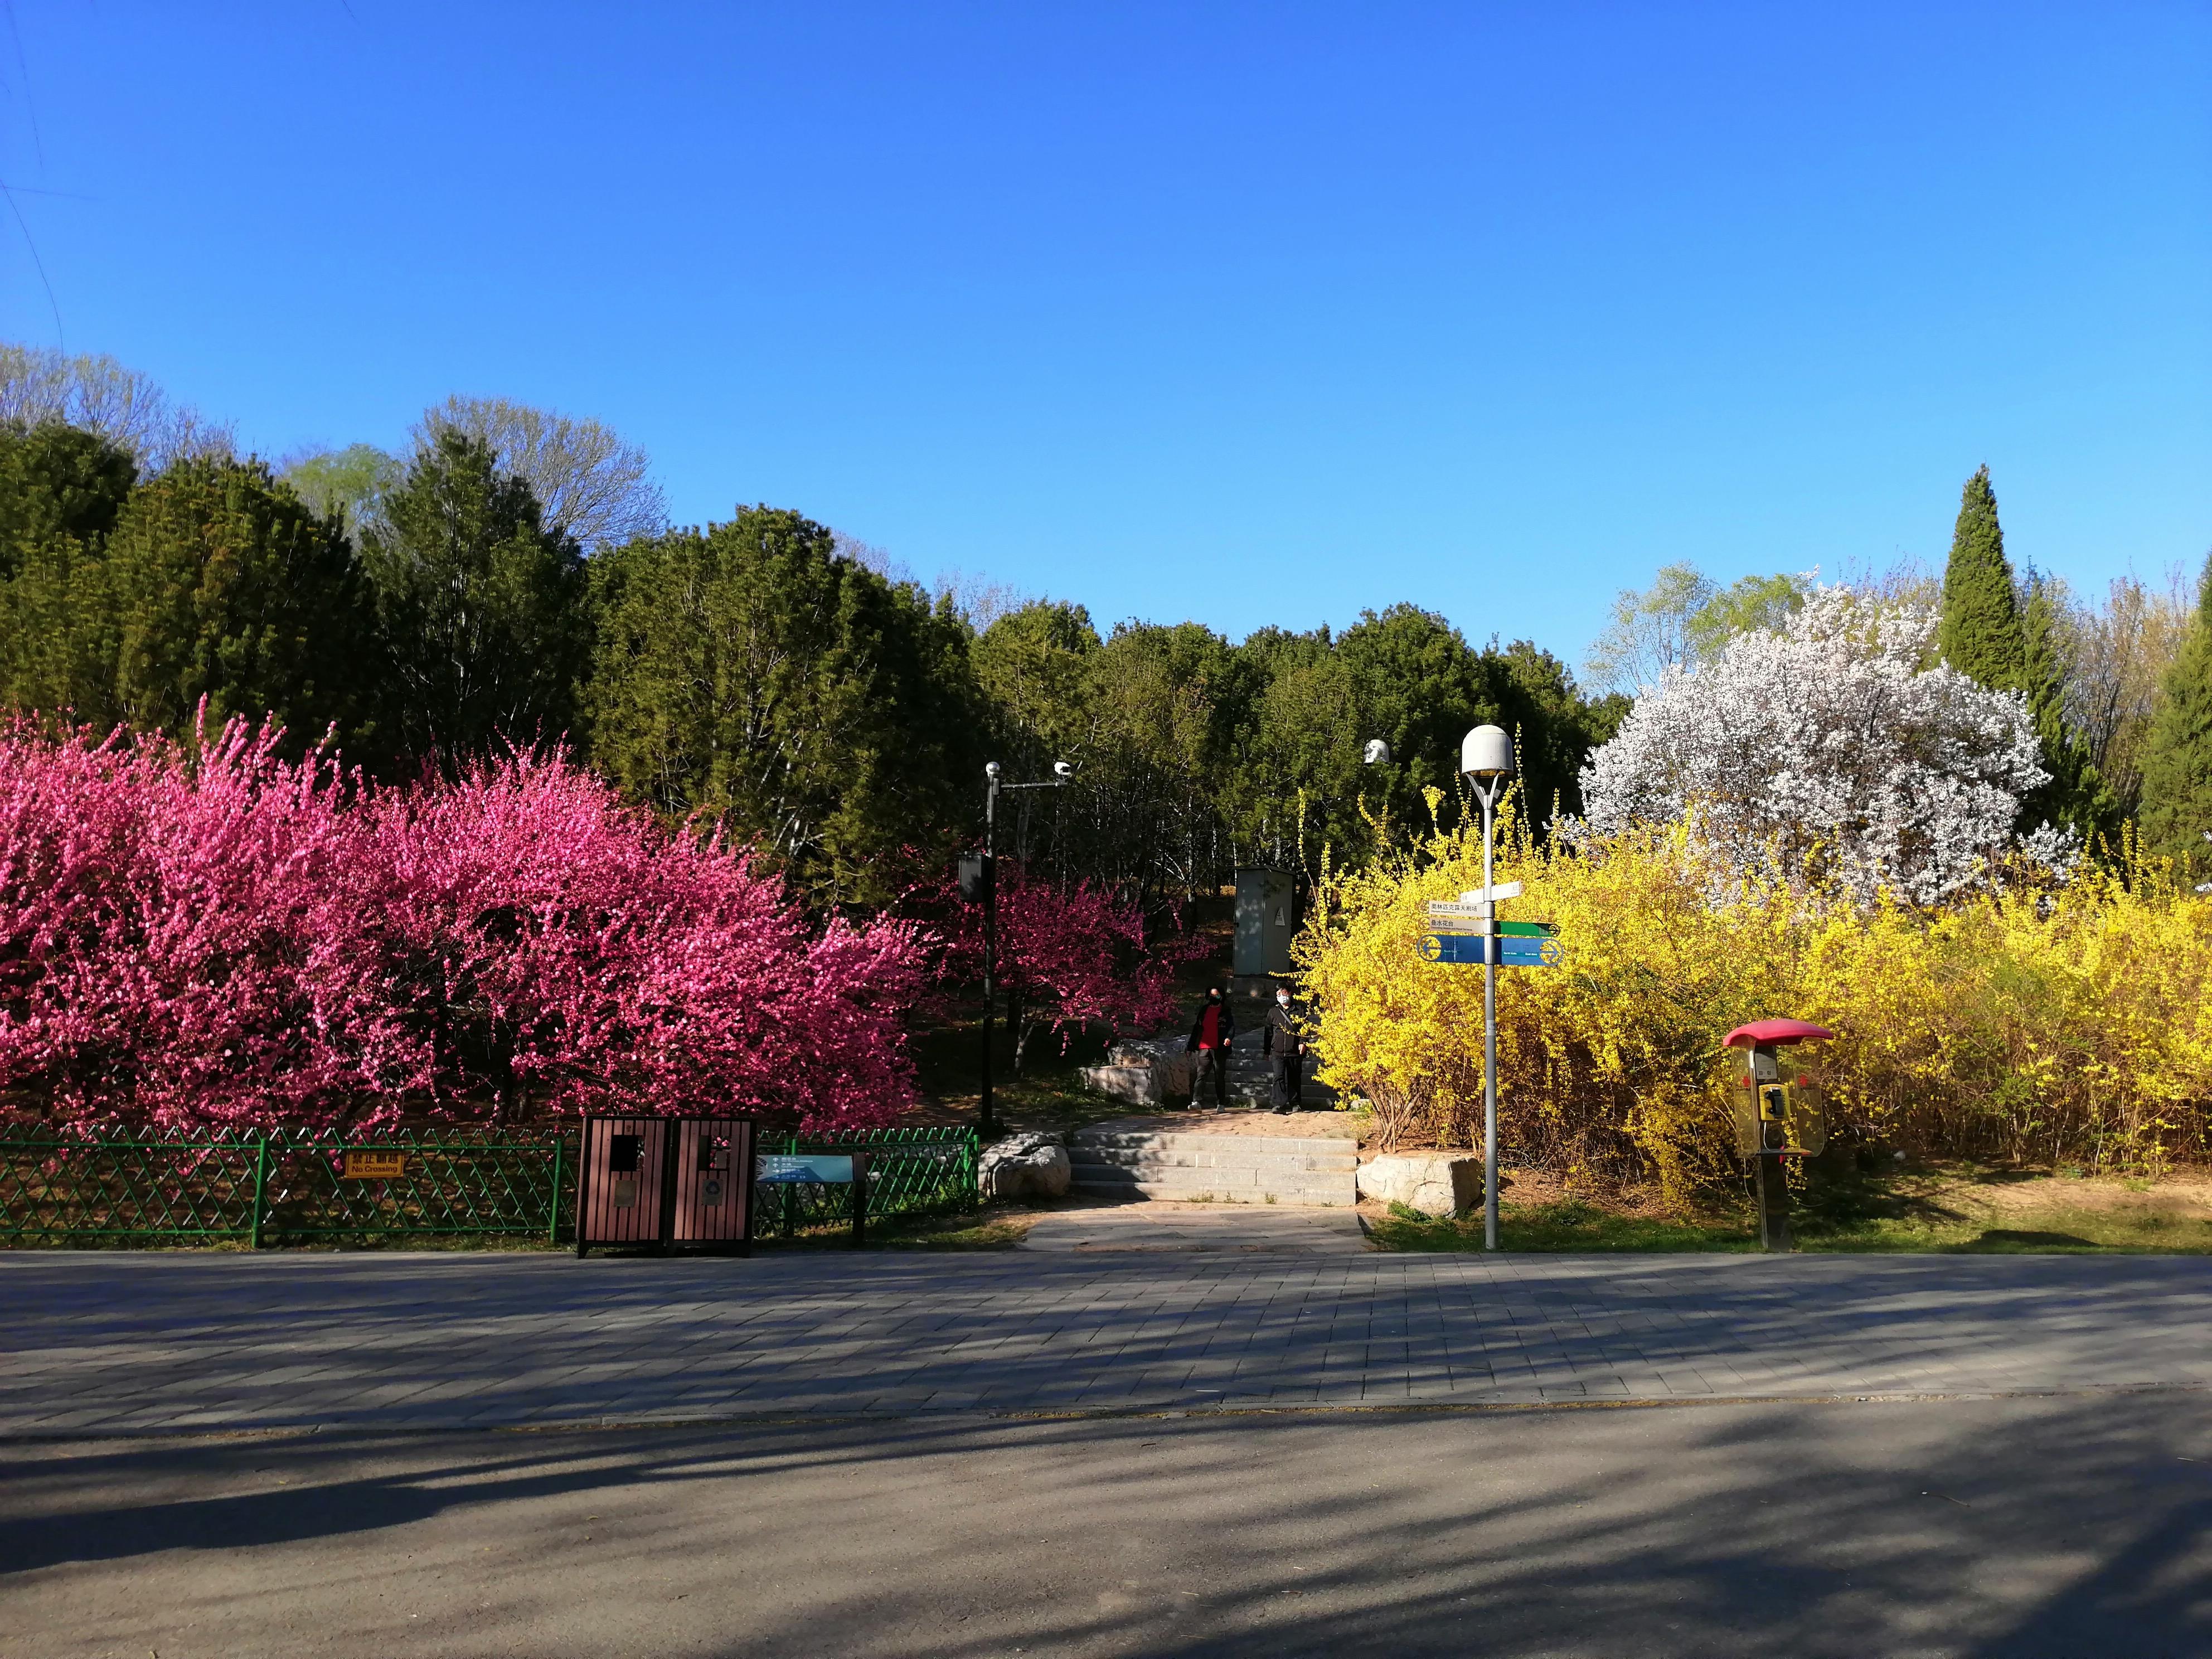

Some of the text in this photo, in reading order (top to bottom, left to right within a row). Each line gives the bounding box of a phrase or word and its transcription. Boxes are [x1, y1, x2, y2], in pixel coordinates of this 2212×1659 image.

[1432, 903, 1477, 912] 奥林匹克露天剧场
